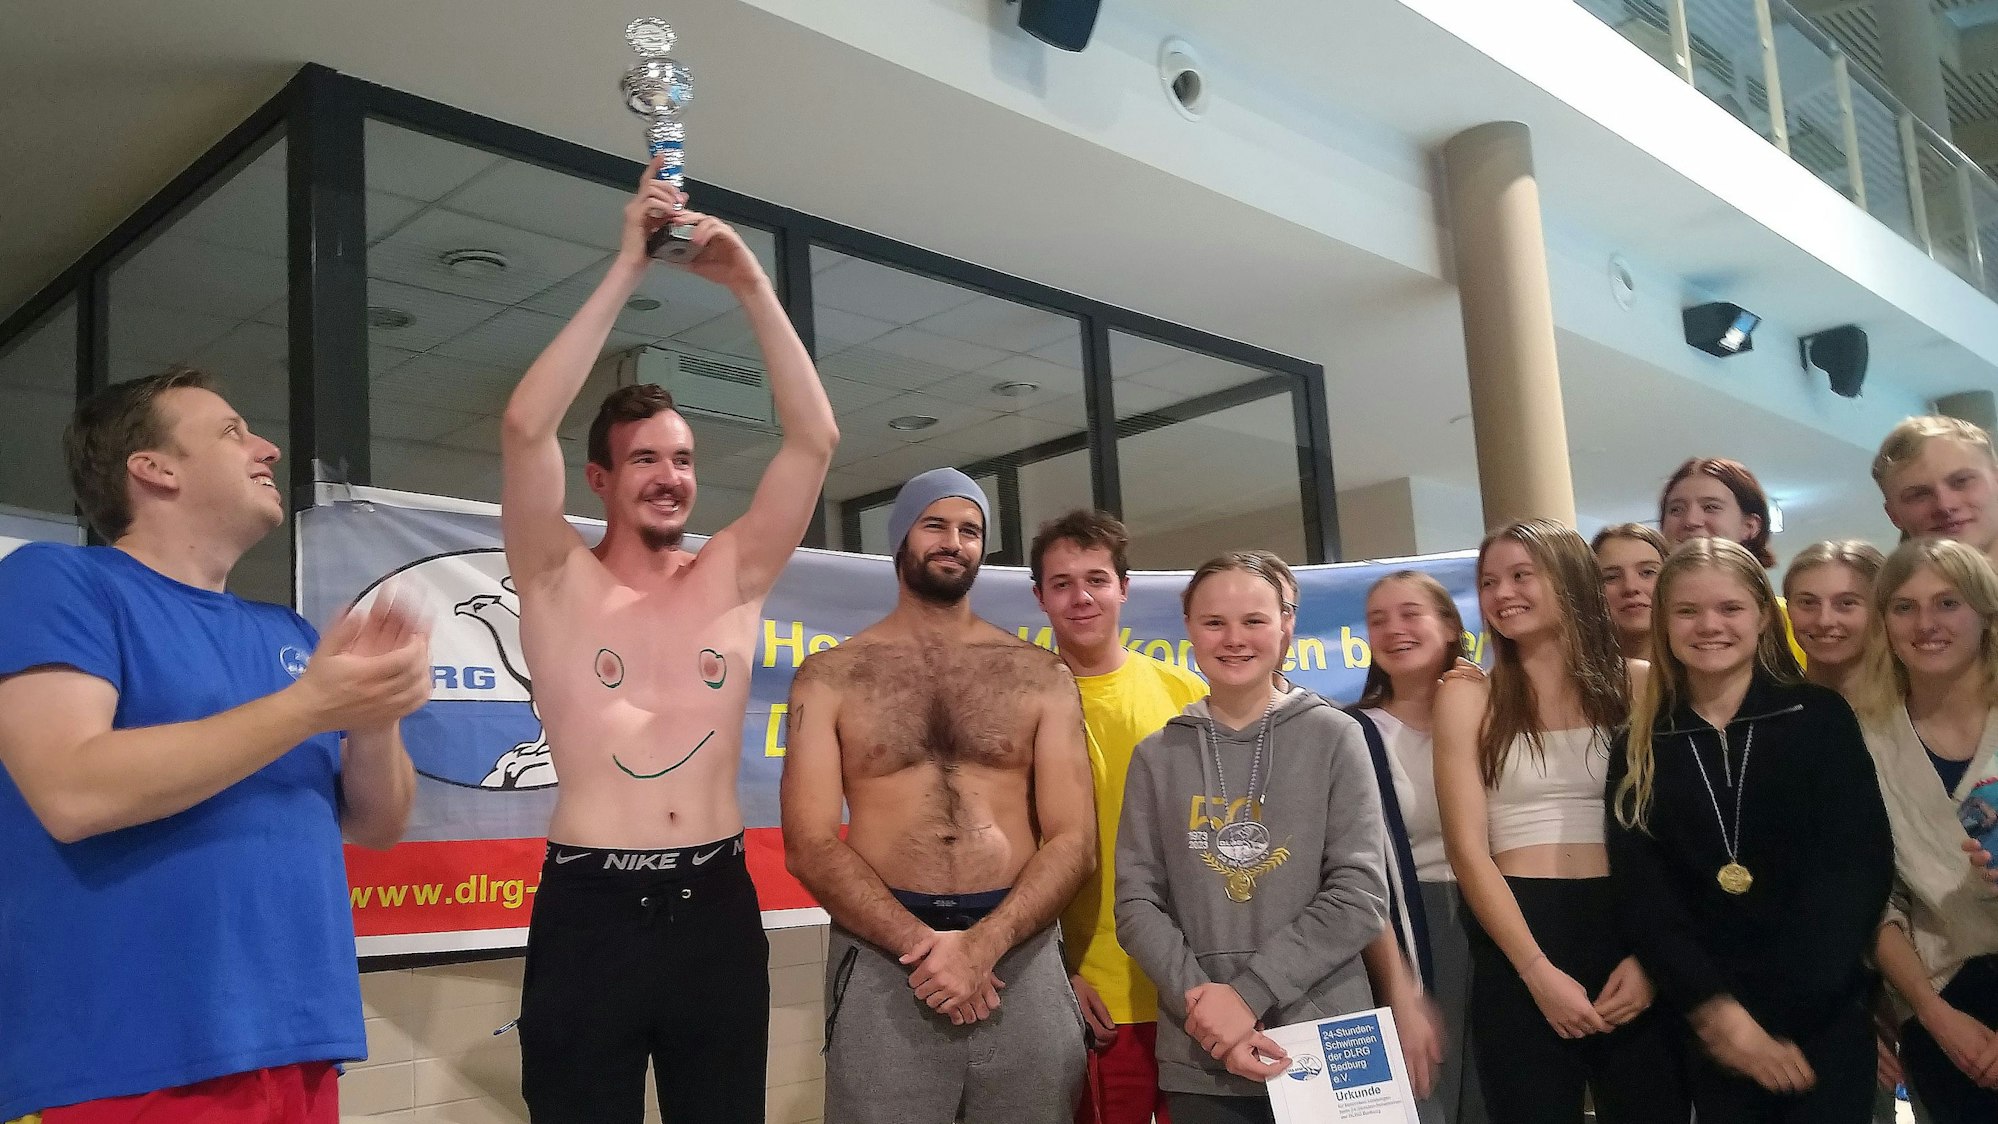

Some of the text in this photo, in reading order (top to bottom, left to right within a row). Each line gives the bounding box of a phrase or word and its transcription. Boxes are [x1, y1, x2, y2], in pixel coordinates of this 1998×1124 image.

[430, 665, 497, 690] RG
[602, 852, 681, 871] NIKE
[350, 871, 544, 911] www.dlrg-
[1322, 1024, 1375, 1040] 24-Stunden-
[1325, 1034, 1378, 1051] Schwimmen
[1327, 1046, 1371, 1062] der DLRG
[1330, 1059, 1367, 1073] Bedburg
[1332, 1073, 1352, 1084] e.V.
[1335, 1085, 1382, 1101] Urkunde
